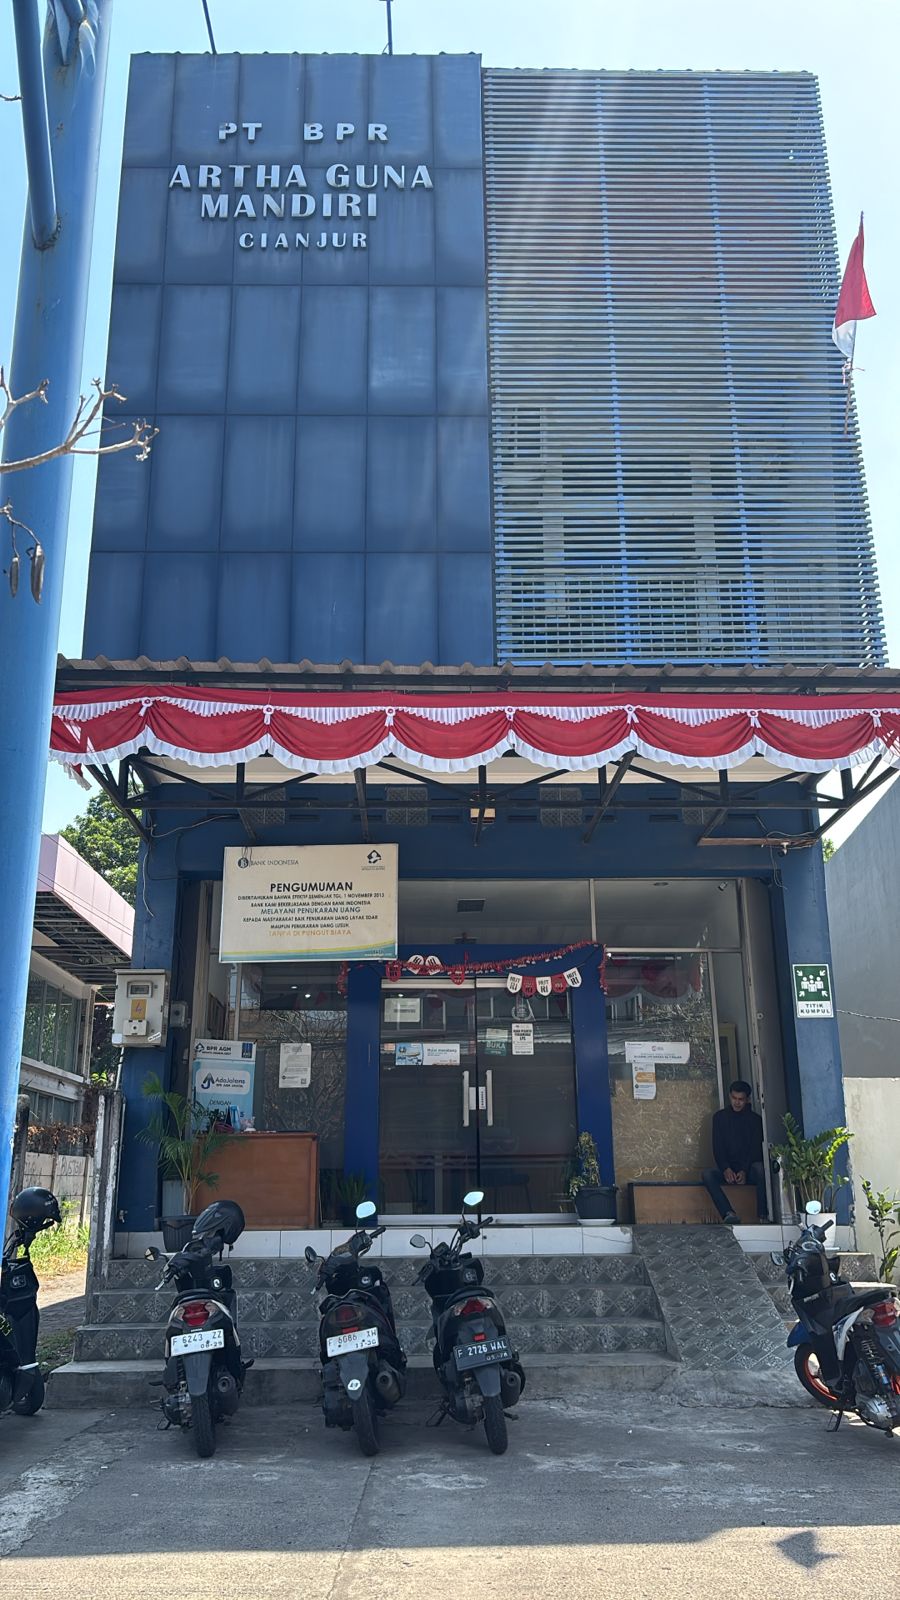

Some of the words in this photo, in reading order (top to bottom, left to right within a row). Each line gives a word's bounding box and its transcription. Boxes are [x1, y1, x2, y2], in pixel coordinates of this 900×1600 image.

[218, 122, 263, 142] PT
[303, 122, 389, 142] BPR
[168, 164, 308, 189] ARTHA
[326, 163, 434, 190] GUNA
[200, 192, 378, 219] MANDIRI
[238, 232, 368, 249] CIANJUR
[270, 882, 353, 893] PENGUMUMAN
[570, 976, 580, 986] RI
[172, 1338, 178, 1346] F
[182, 1334, 203, 1344] 6243
[212, 1330, 222, 1339] ZZ
[457, 1349, 463, 1358] F
[467, 1344, 488, 1356] 2726
[490, 1340, 507, 1350] WAL
